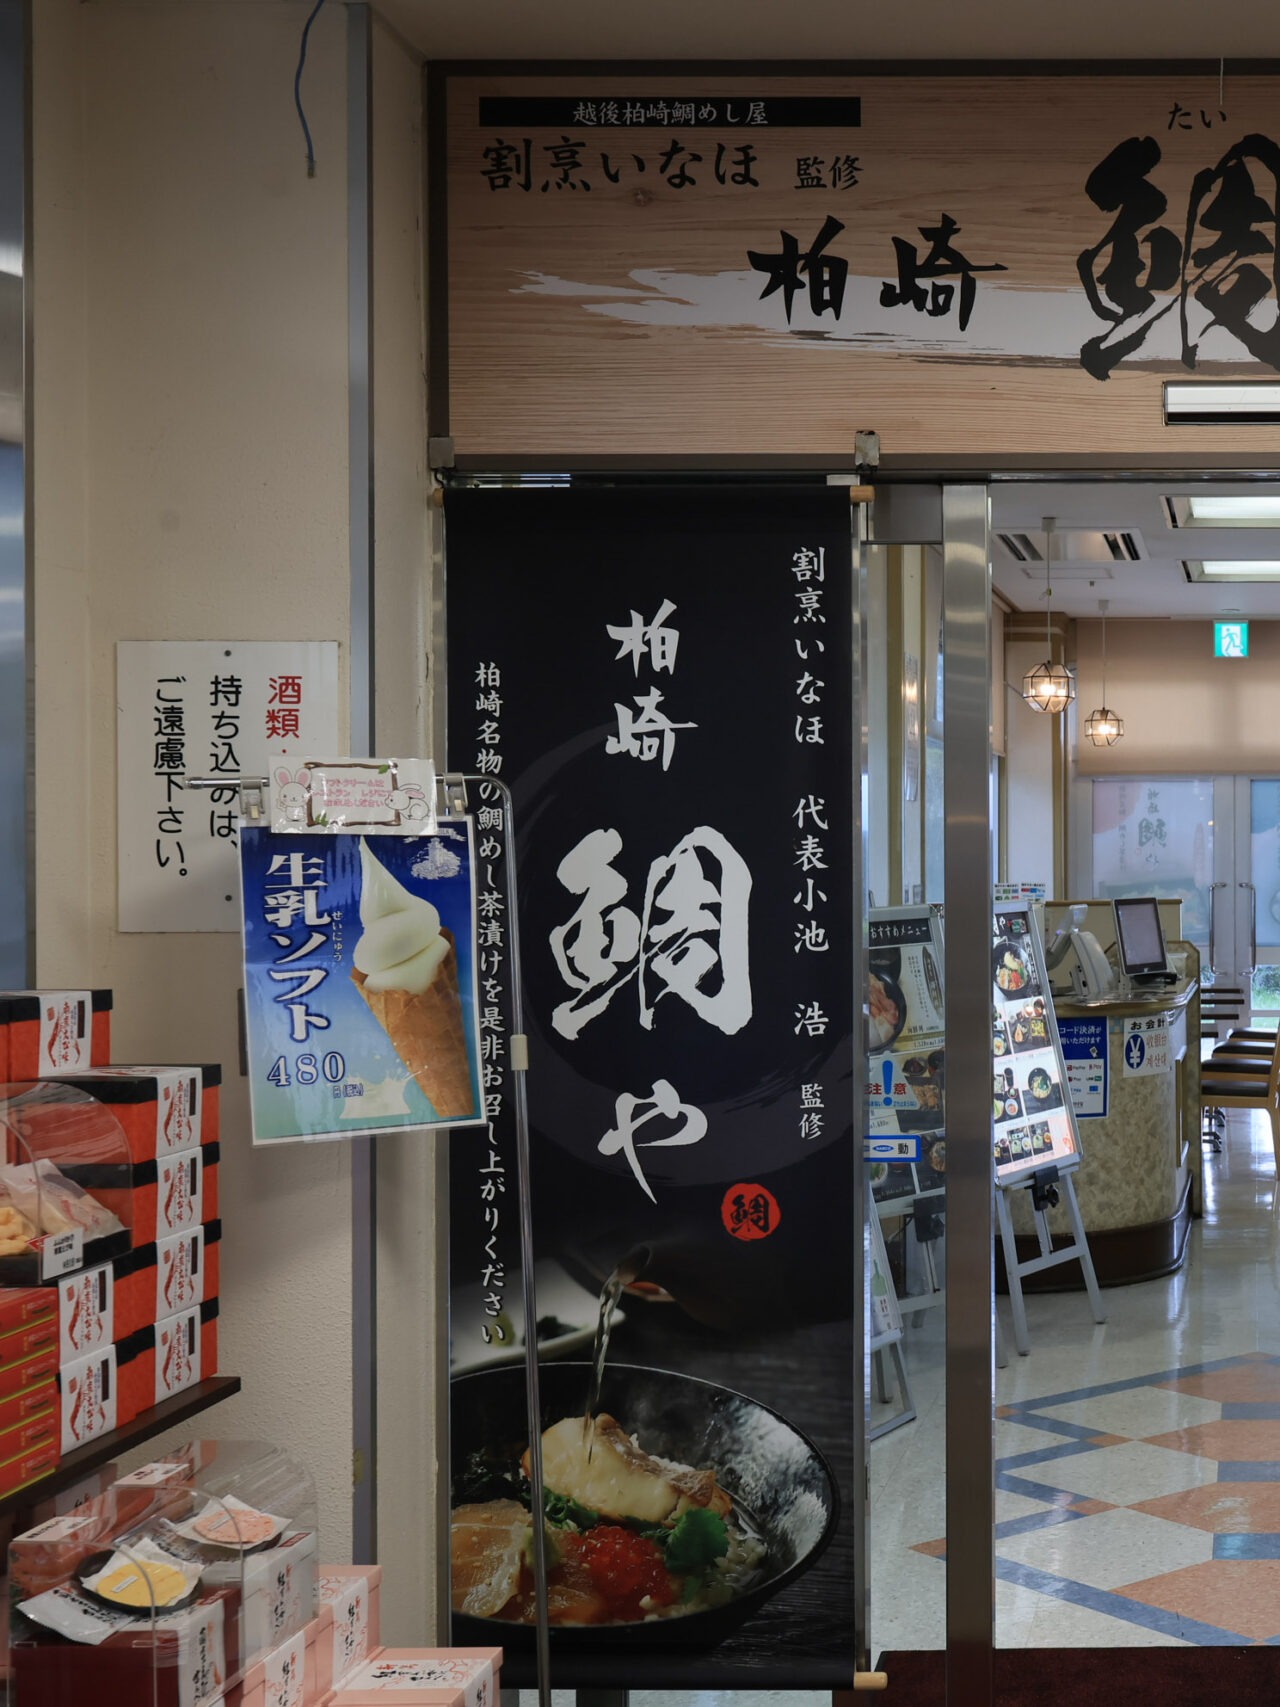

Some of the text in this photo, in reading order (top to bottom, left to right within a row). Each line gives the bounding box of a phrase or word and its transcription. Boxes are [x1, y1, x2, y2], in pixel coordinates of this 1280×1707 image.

[573, 101, 769, 126] 越後柏崎鯛めし屋
[1167, 102, 1228, 130] たい
[480, 136, 864, 192] 割烹いなほ 監修
[153, 675, 188, 877] ご遠慮下さい。
[791, 546, 829, 1139] 割烹いなほ 代表小池 浩 監修
[264, 851, 331, 1042] 生乳ソフト
[331, 910, 344, 963] せいにゅう
[475, 661, 506, 1344] 柏崎名物の鯛めし茶漬けを是非お召し上がりください
[1131, 1019, 1165, 1030] お会計
[267, 1052, 346, 1087] 480
[731, 1194, 770, 1234] 鯛
